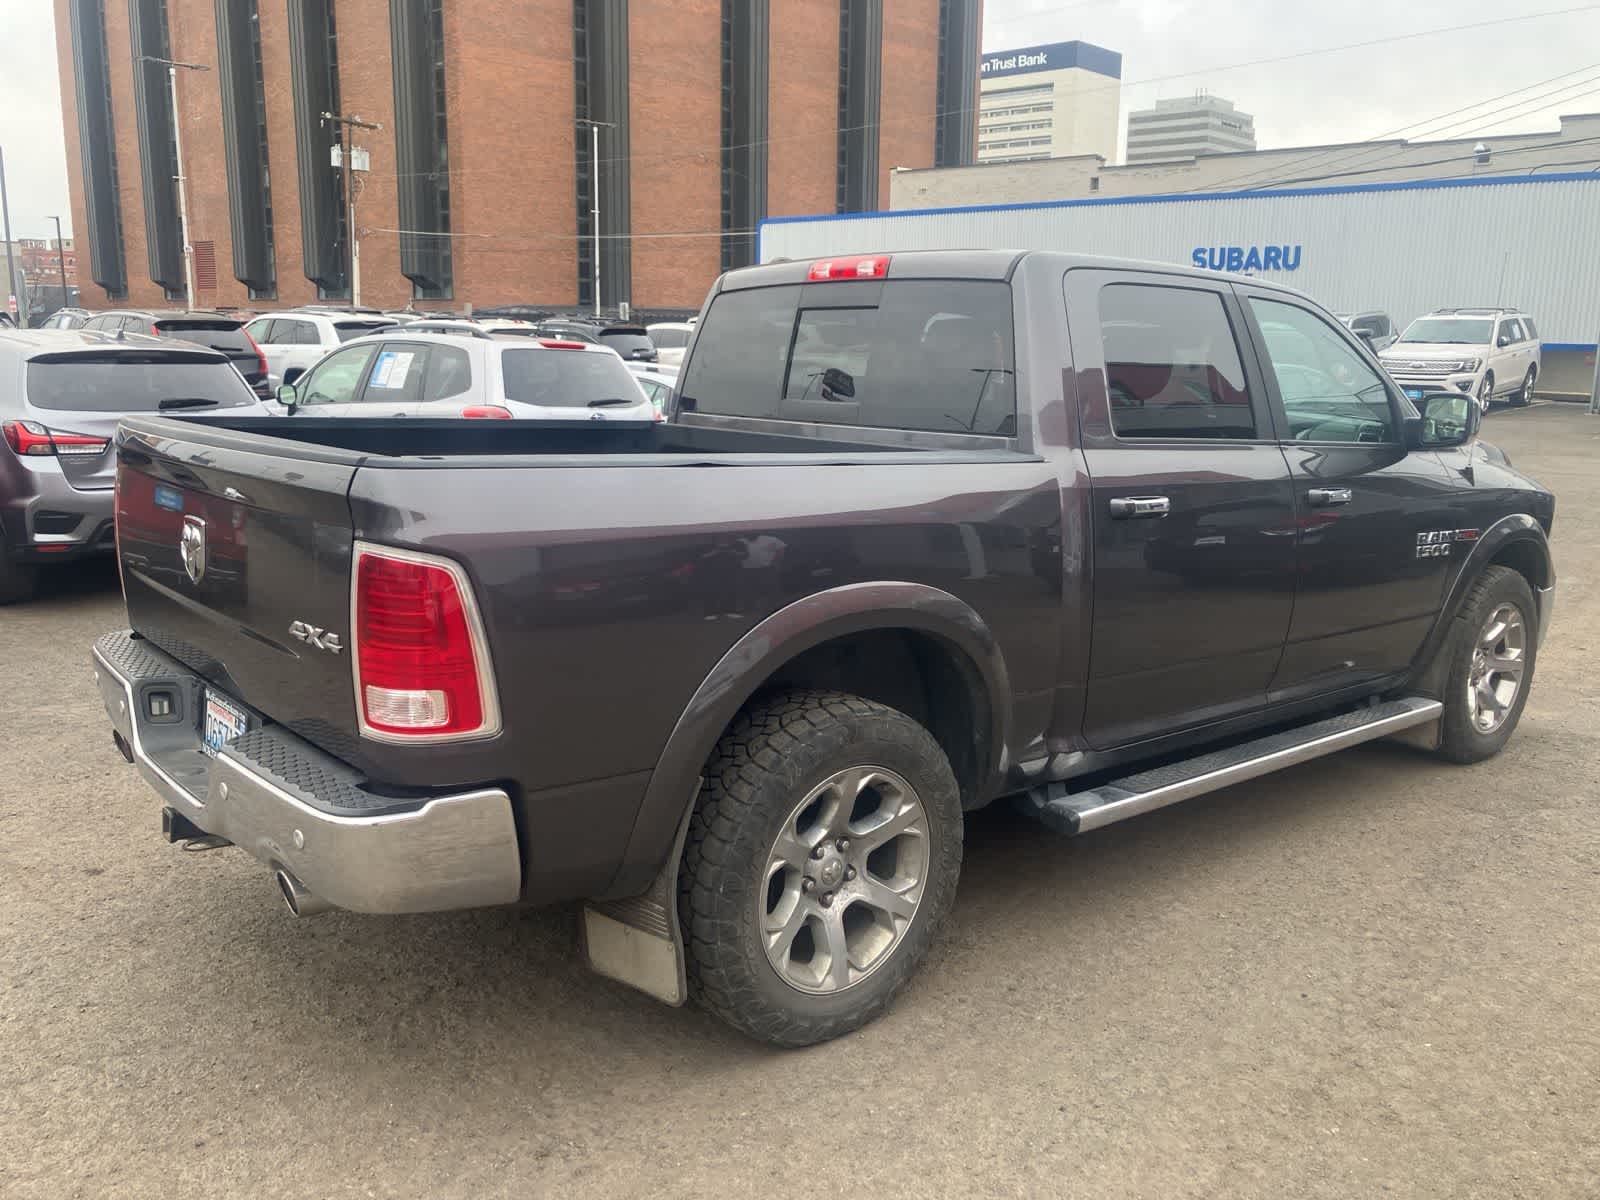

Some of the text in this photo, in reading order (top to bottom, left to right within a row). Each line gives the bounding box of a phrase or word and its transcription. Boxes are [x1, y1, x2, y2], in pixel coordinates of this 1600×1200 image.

[990, 56, 1017, 71] Trust
[1018, 51, 1047, 67] Bank
[1192, 245, 1302, 271] SUBARU
[1416, 530, 1453, 544] RAM
